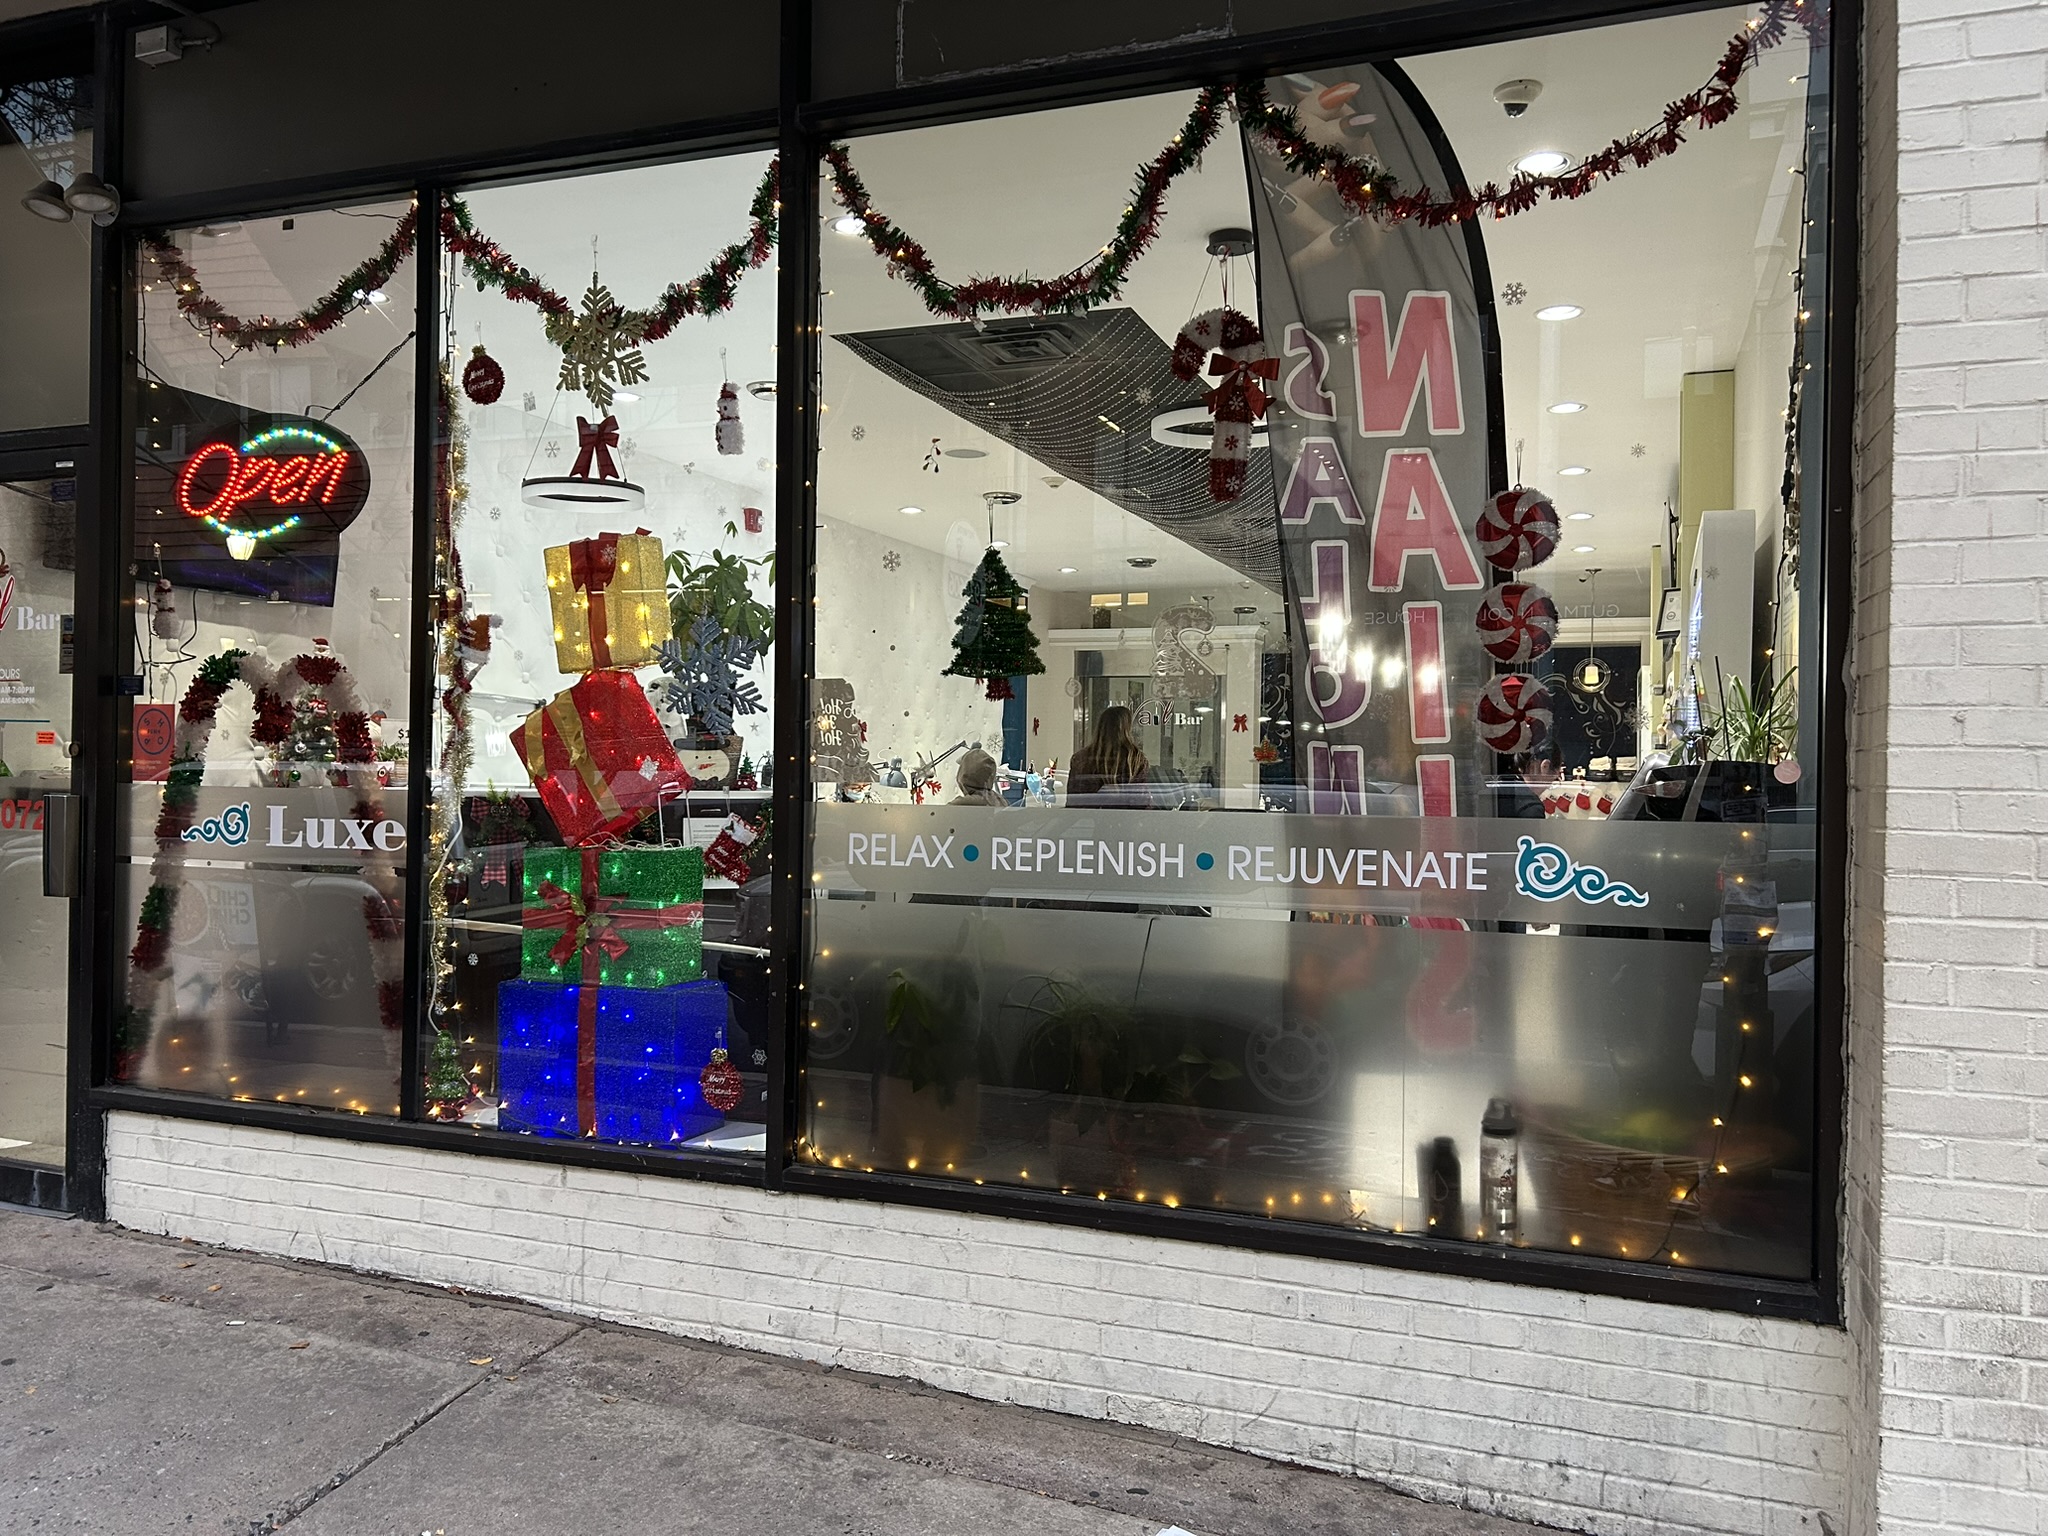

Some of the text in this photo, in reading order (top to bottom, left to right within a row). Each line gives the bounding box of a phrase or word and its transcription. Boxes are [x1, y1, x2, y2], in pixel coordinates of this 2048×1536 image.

[177, 442, 349, 522] Open
[16, 606, 61, 631] Bar
[1174, 713, 1204, 725] Bar
[265, 804, 407, 852] Luxe
[848, 832, 1488, 891] RELAX REPLENISH REJUVENATE
